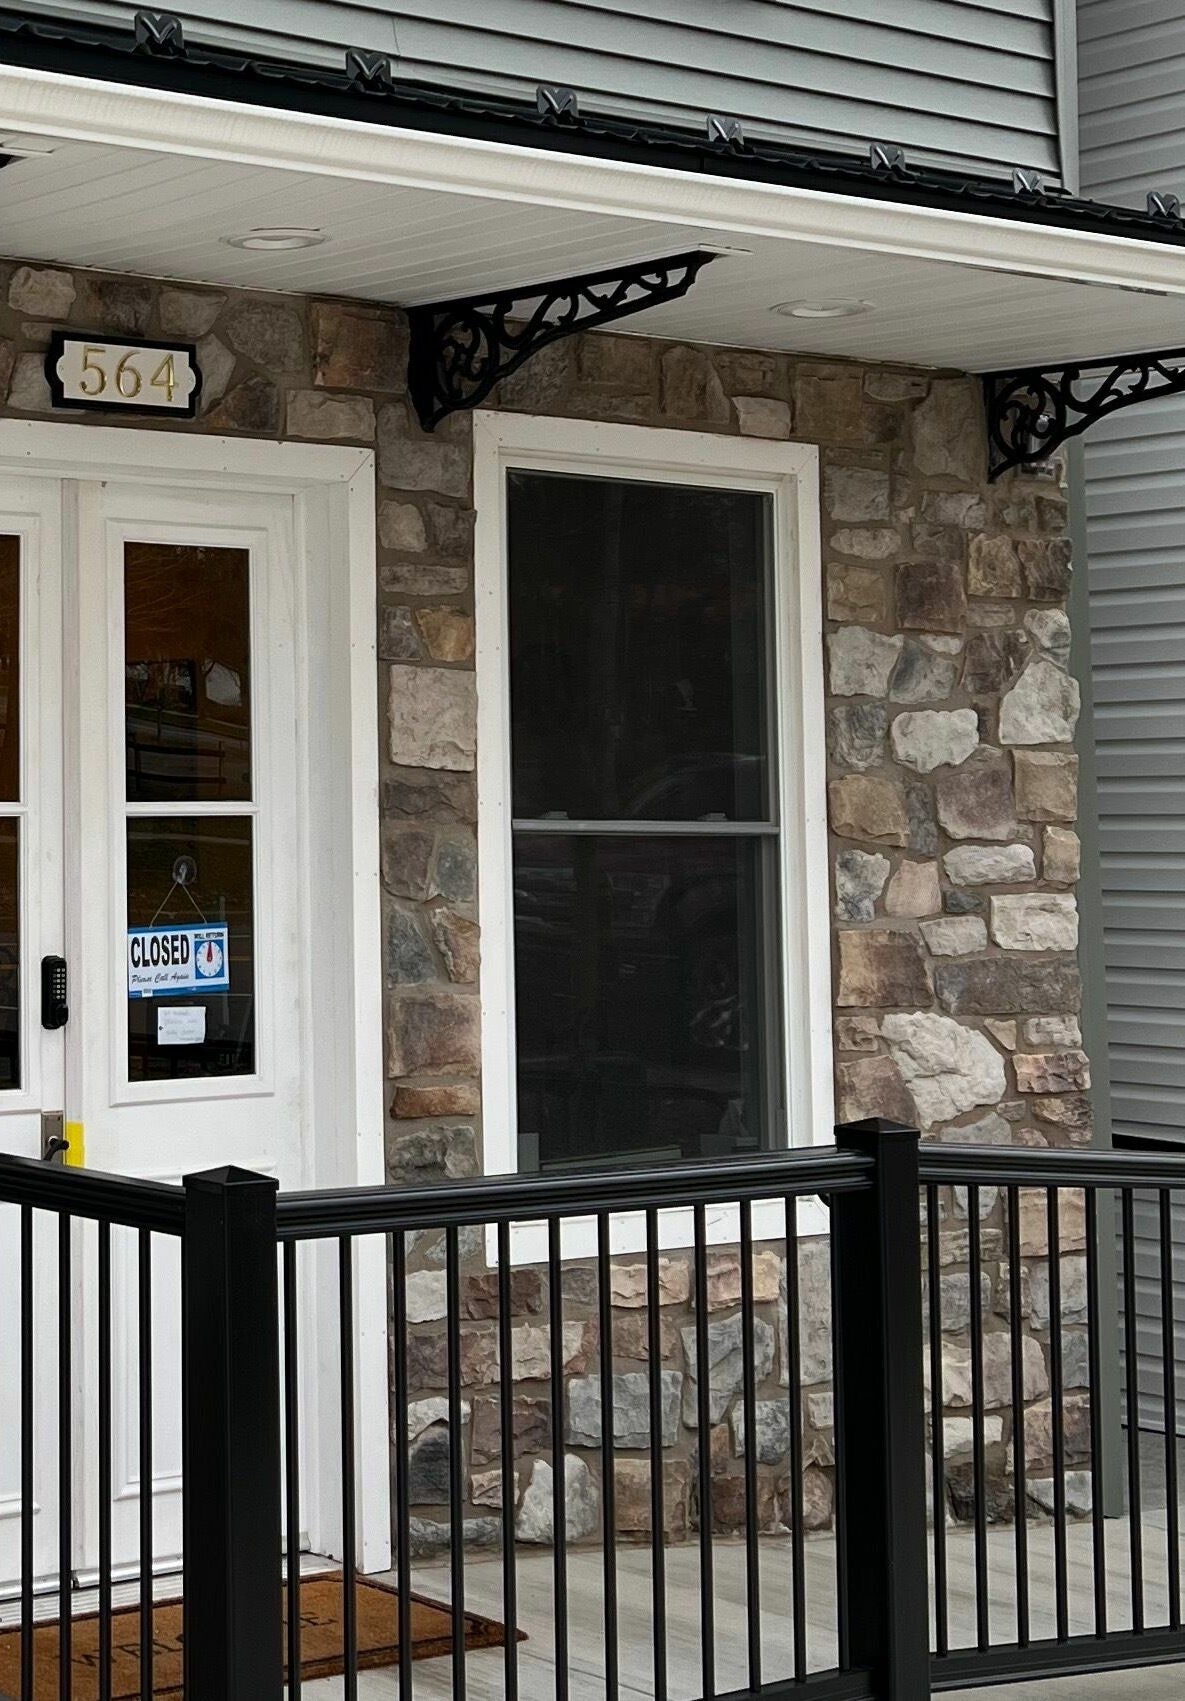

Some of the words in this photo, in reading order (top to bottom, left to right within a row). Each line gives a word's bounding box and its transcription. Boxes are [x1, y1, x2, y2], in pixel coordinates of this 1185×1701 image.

[80, 344, 179, 402] 564
[131, 934, 189, 968] CLOSED
[154, 972, 168, 983] Call
